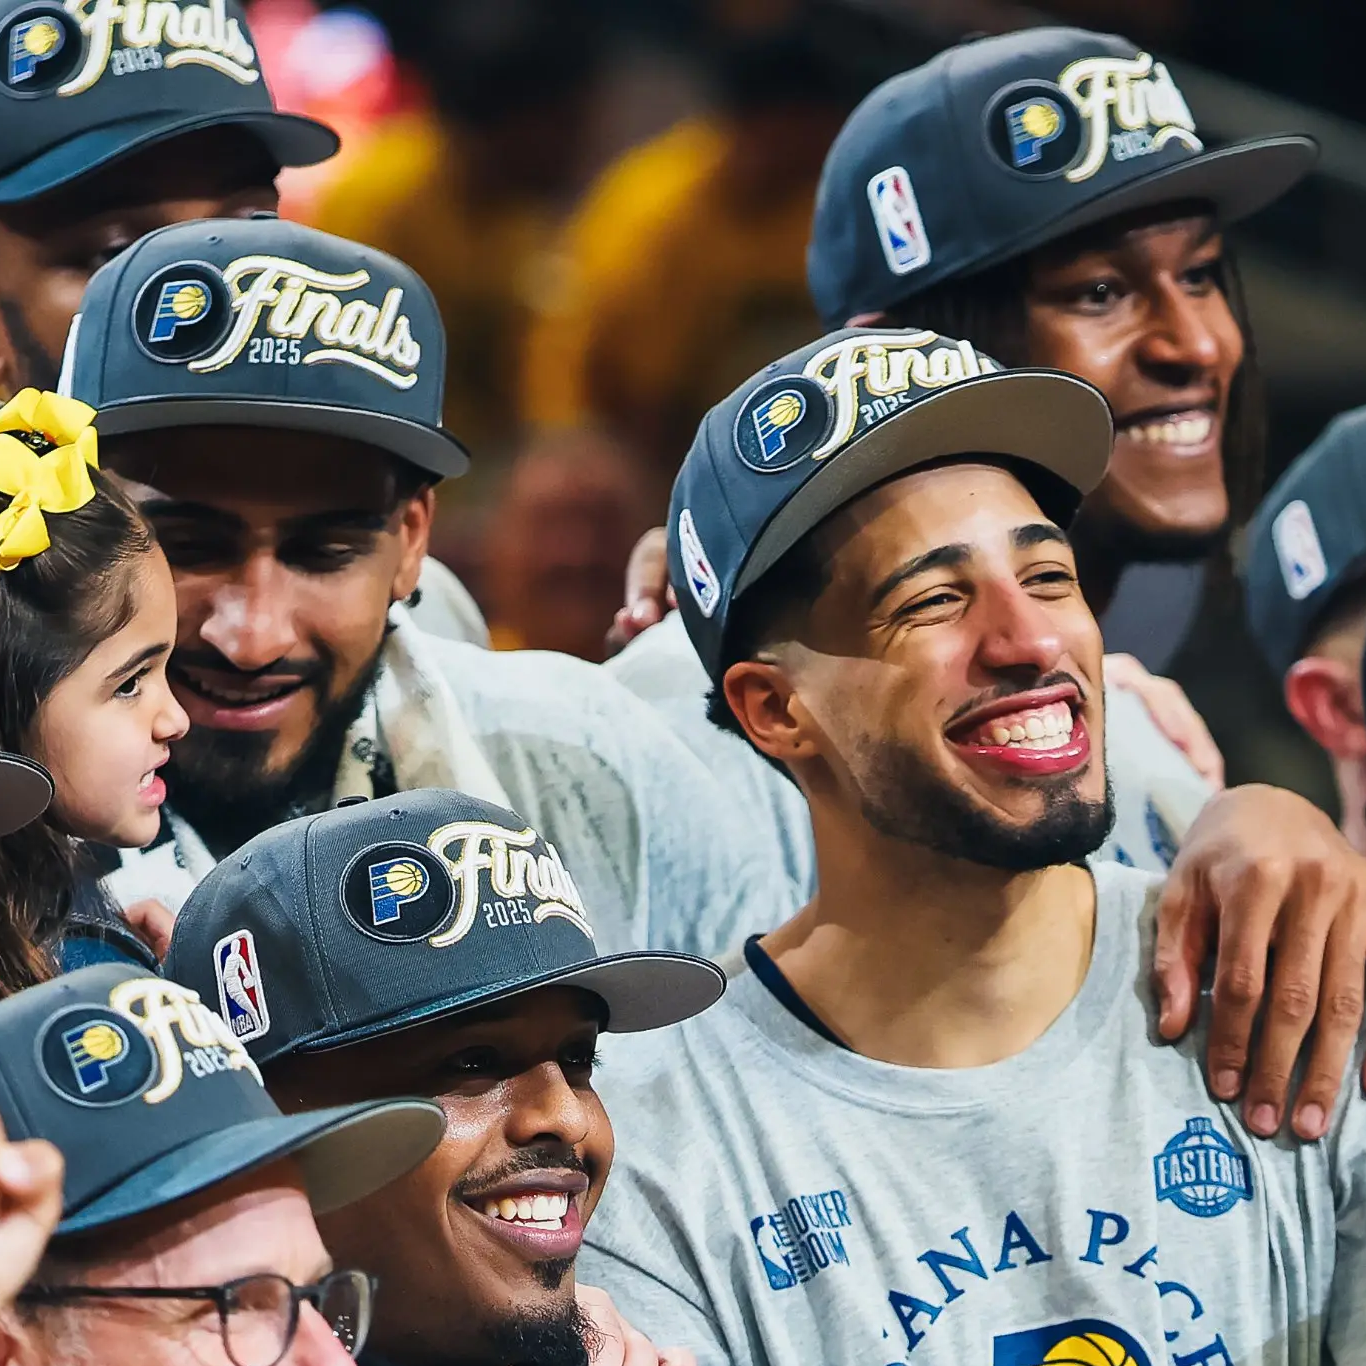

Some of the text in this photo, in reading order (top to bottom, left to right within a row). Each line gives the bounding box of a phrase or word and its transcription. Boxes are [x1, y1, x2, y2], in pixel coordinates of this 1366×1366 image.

[188, 255, 421, 373] Finals
[248, 337, 302, 365] 2025
[483, 900, 532, 928] 2025
[1157, 1149, 1246, 1190] EASTERN
